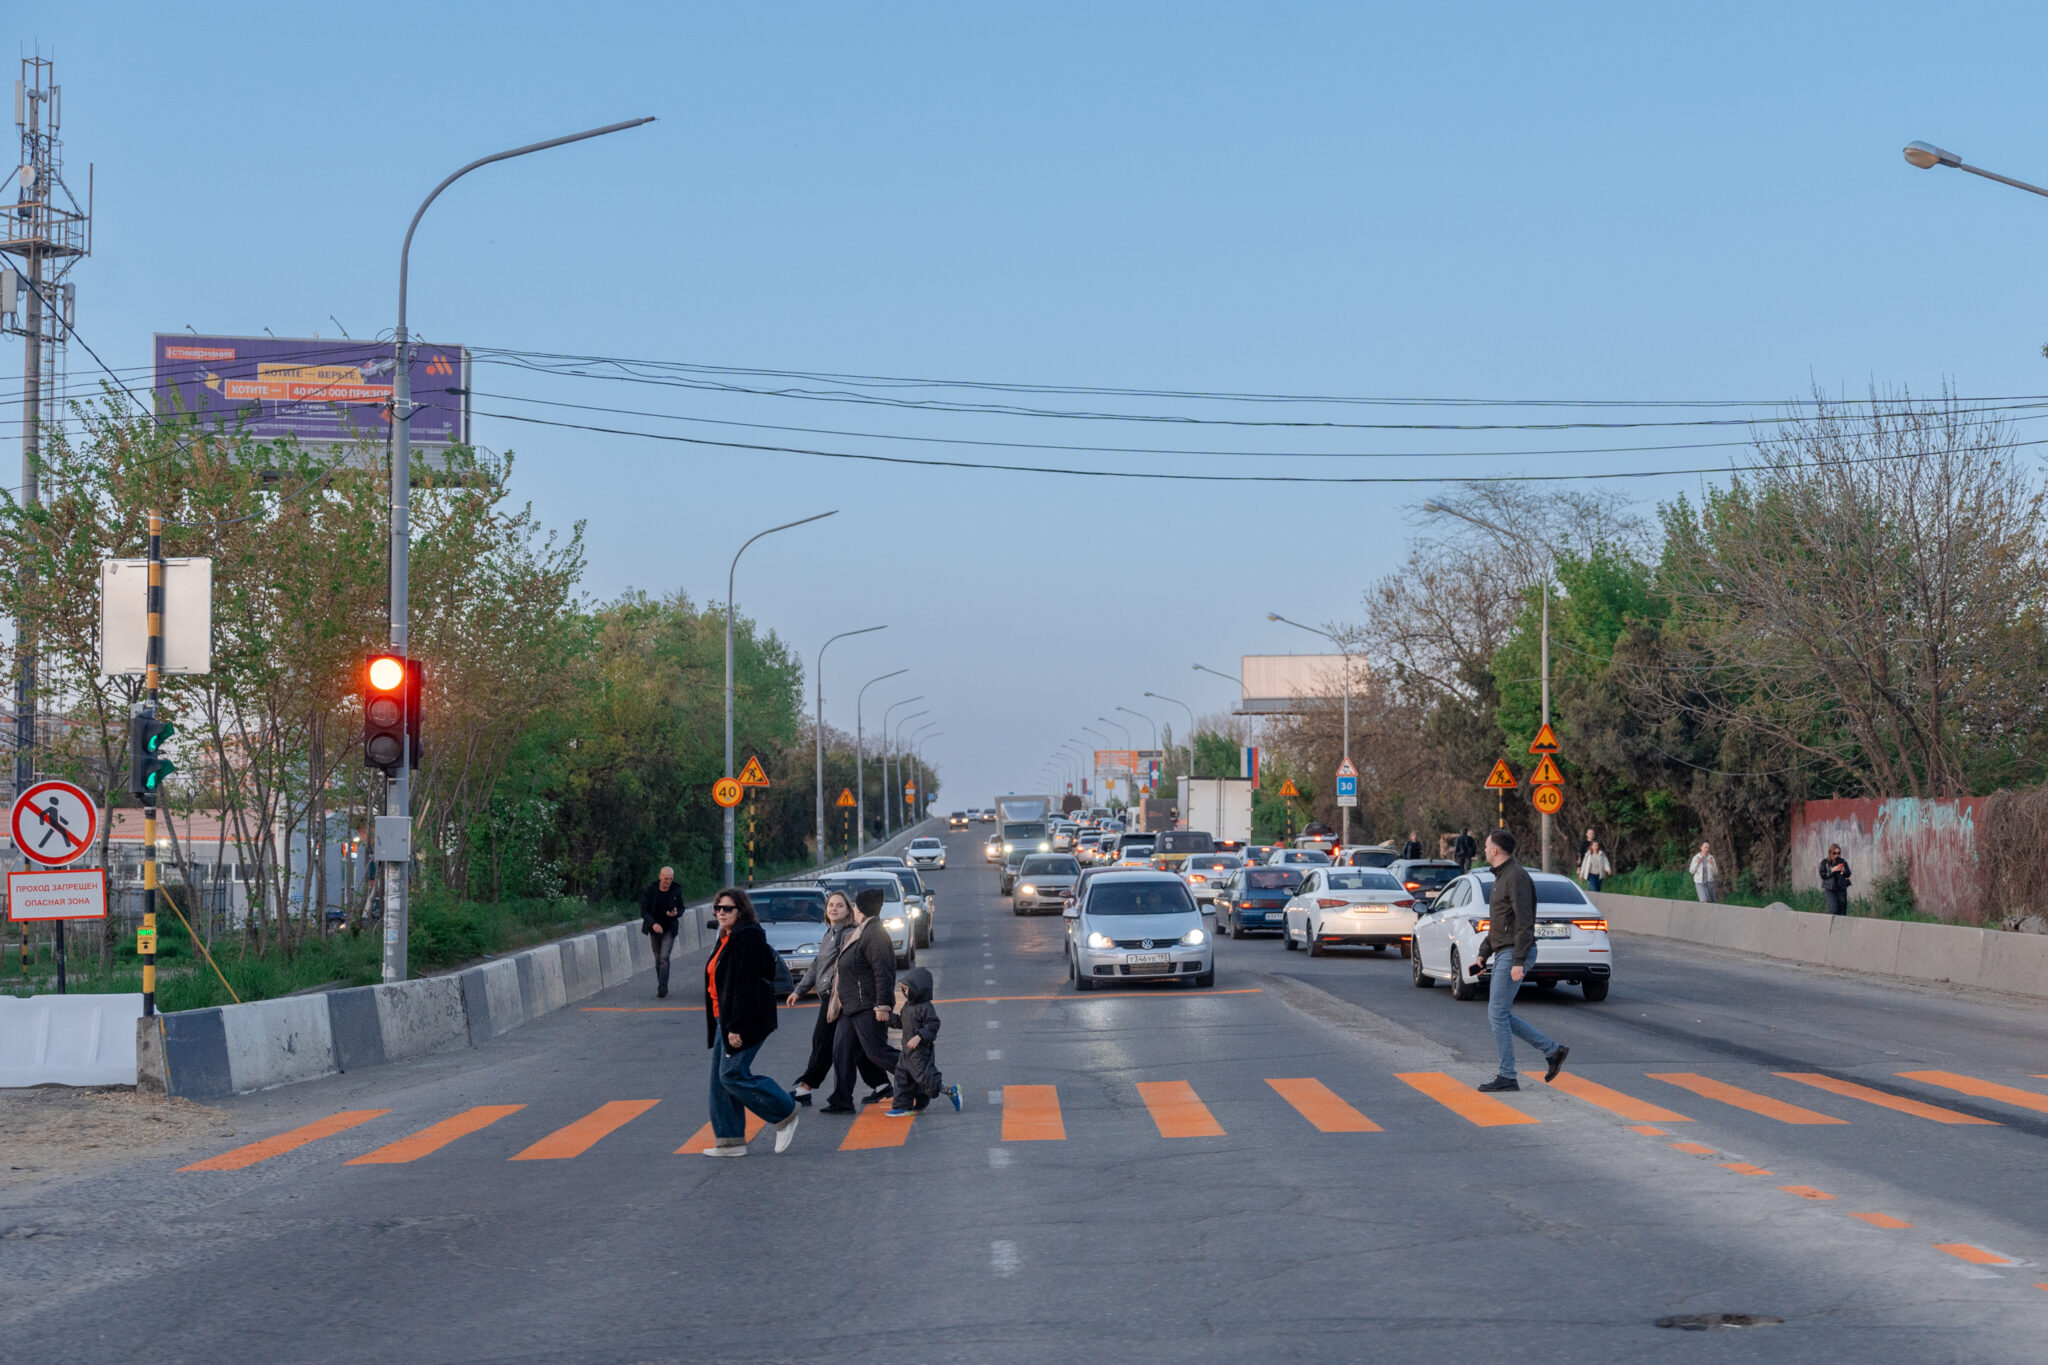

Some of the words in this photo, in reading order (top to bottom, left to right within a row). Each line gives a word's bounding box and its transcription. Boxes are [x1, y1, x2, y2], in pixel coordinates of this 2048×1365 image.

[264, 368, 302, 378] ХОТИТЕ
[231, 384, 269, 395] ХОТИТЕ
[293, 386, 306, 396] 40
[328, 388, 347, 397] 000
[1341, 782, 1353, 790] 30
[719, 786, 737, 798] 40
[1539, 792, 1557, 805] 40
[15, 884, 50, 893] ПРОХОД
[52, 882, 98, 891] ЗАПРЕЩЕН
[25, 898, 66, 907] ОПАСНАЯ
[68, 897, 90, 905] ЗОНА
